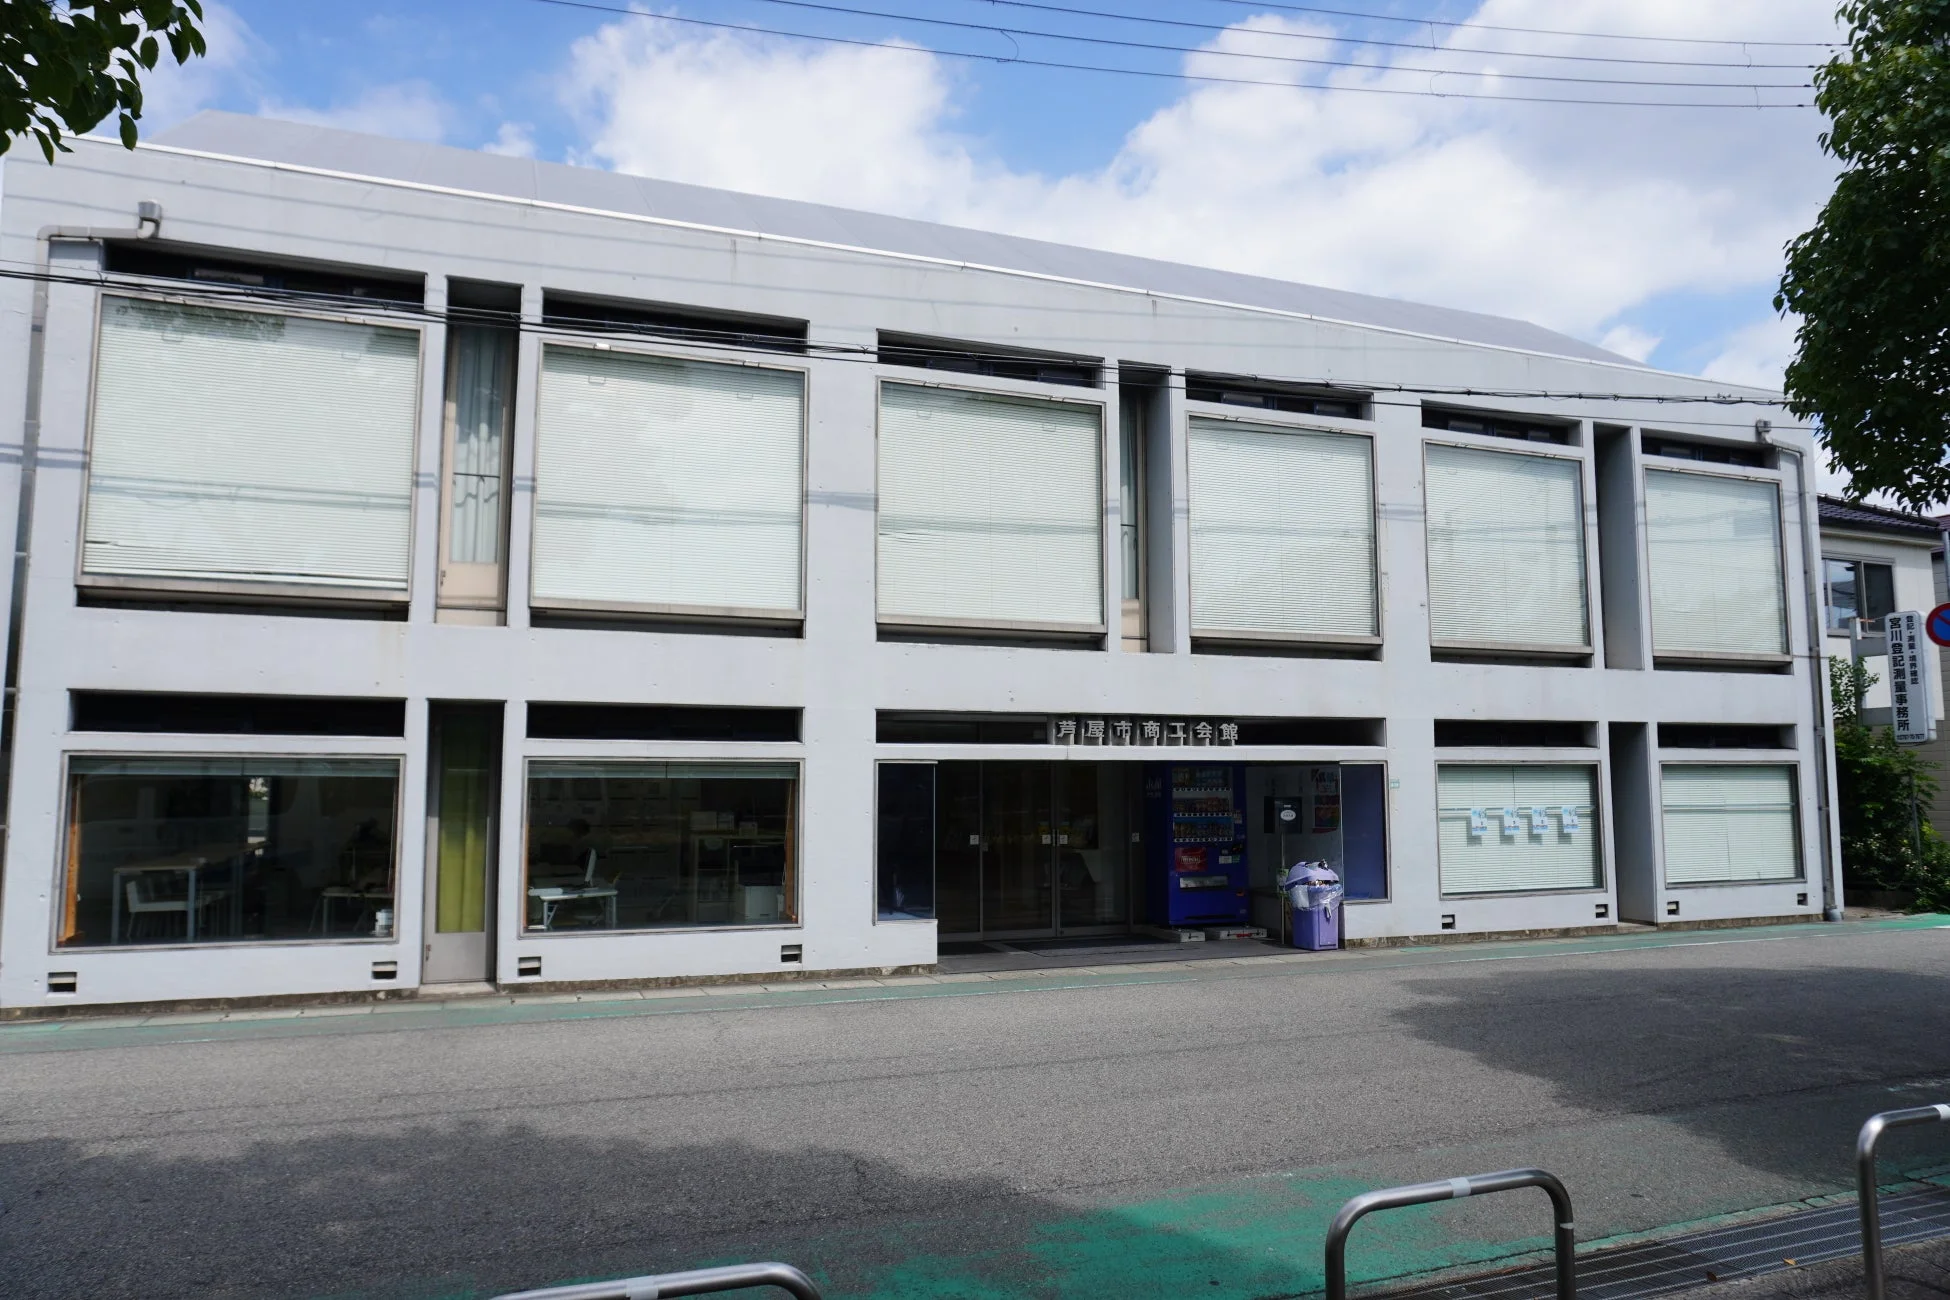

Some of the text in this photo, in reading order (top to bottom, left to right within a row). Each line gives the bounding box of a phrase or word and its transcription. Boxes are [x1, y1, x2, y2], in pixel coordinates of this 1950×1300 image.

[1889, 617, 1910, 731] 宮川登記測量事務所
[1056, 719, 1240, 741] 芦屋市商工会館
